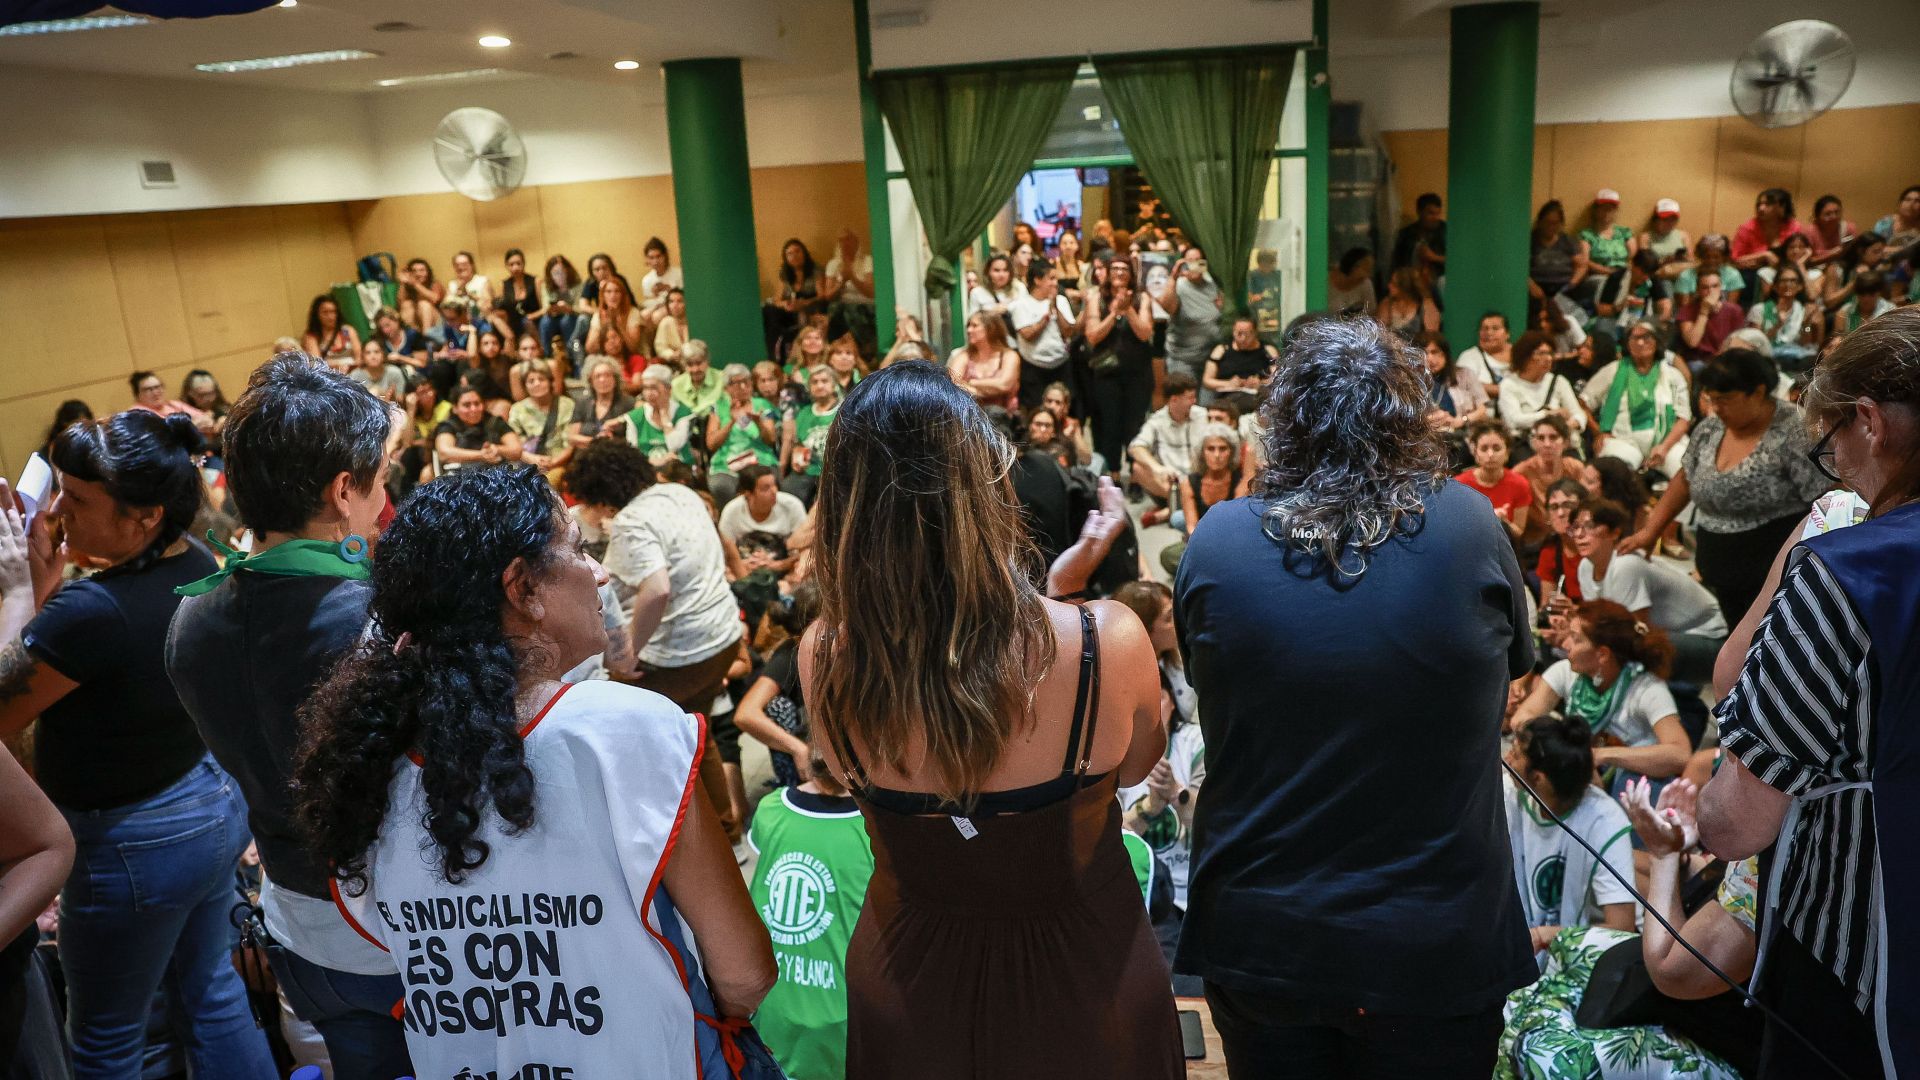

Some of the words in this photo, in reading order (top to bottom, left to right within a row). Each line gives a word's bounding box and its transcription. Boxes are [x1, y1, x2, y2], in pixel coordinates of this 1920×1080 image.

[773, 867, 819, 927] ATE
[407, 935, 453, 986] ES
[464, 929, 561, 983] CON
[794, 955, 836, 989] BLANCA
